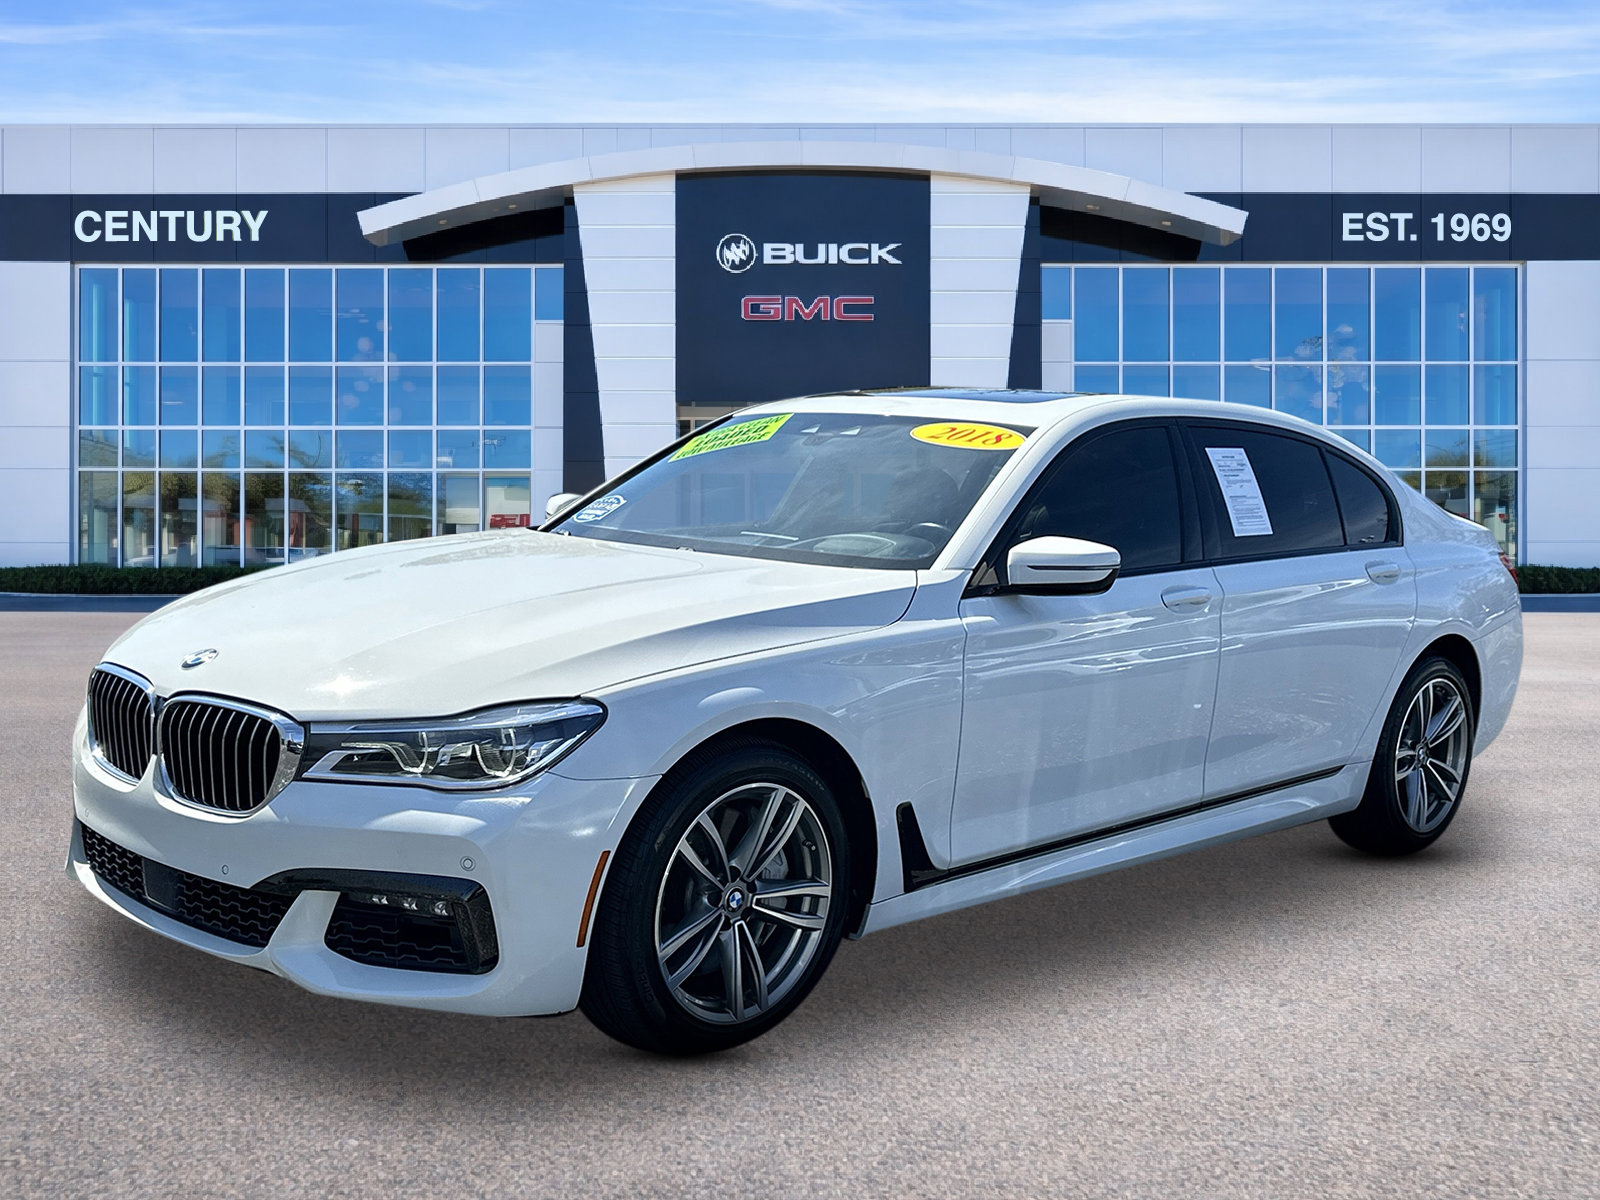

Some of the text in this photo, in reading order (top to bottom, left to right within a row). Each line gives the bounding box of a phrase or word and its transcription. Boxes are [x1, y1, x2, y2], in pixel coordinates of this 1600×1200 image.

[74, 210, 269, 243] CENTURY
[1342, 212, 1513, 242] EST. 1969
[763, 242, 903, 265] BUICK
[741, 295, 875, 321] GMC
[694, 425, 769, 448] LOADED
[926, 427, 1013, 445] 2018
